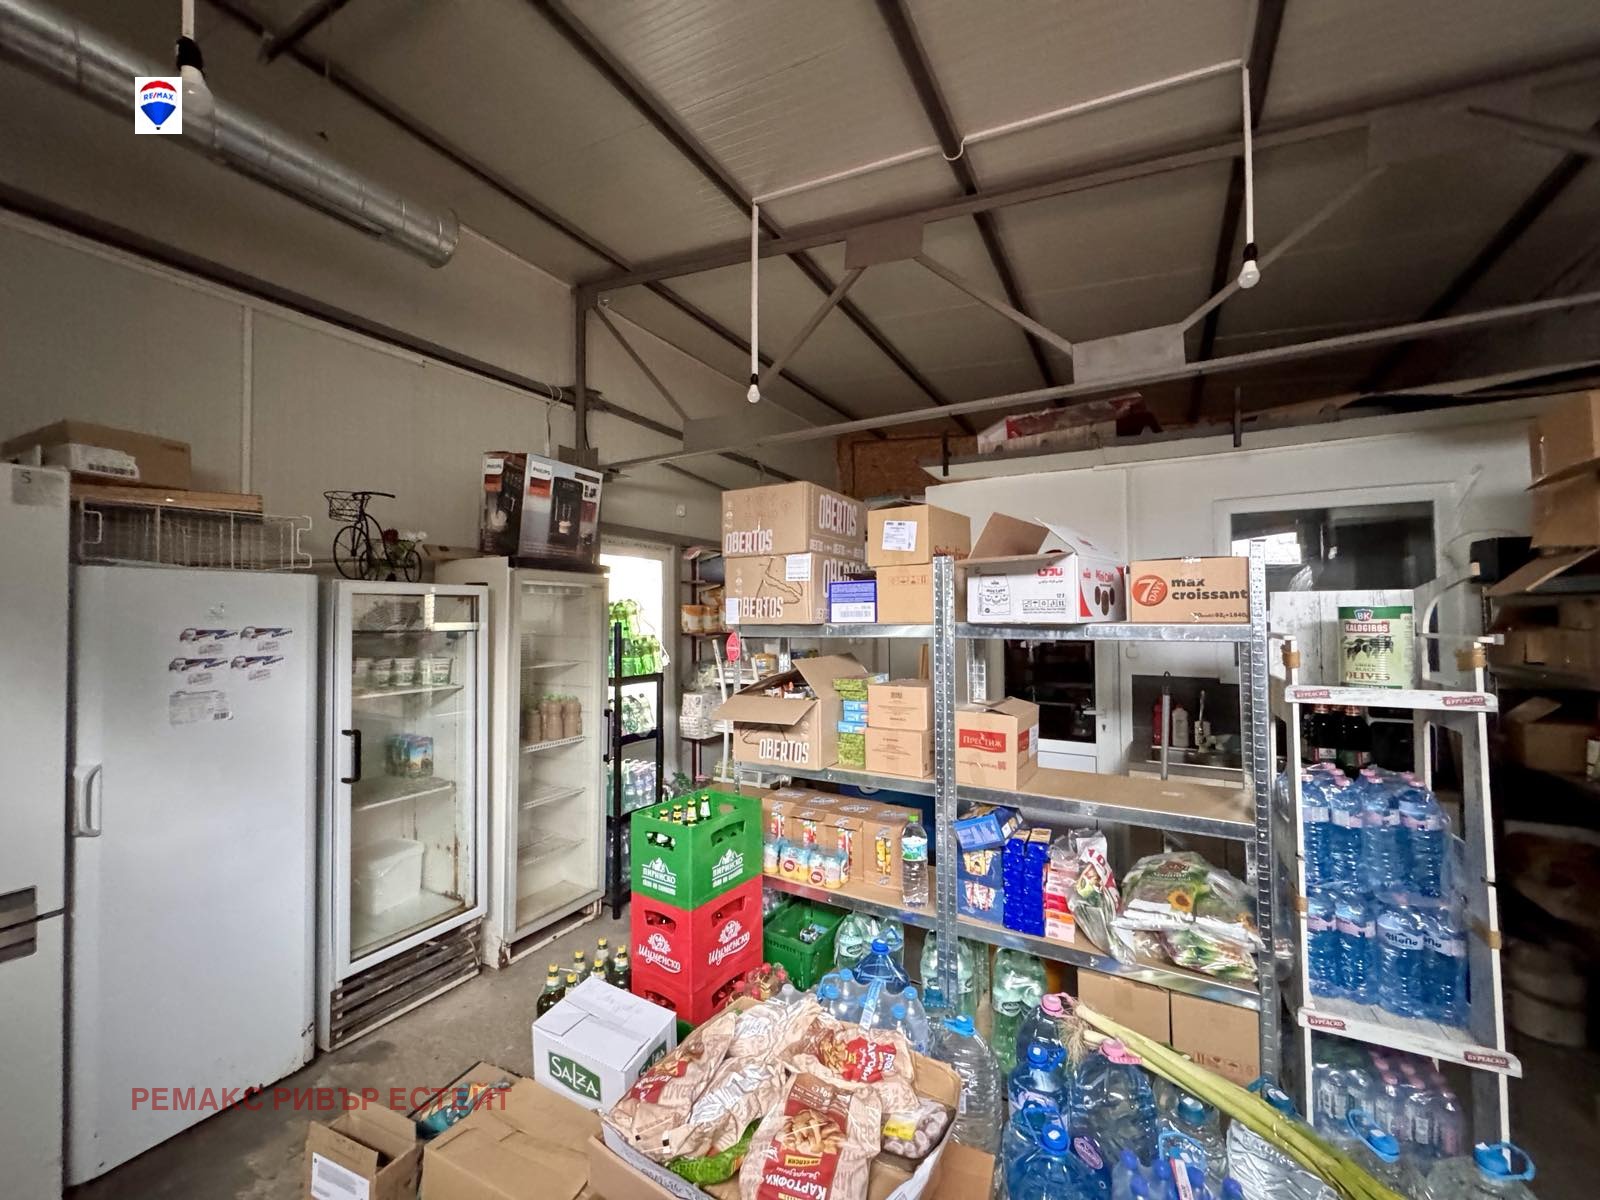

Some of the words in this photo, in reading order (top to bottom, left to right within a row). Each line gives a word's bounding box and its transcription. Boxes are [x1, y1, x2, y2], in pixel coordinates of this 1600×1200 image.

[819, 494, 857, 537] OBERTOS
[725, 529, 773, 555] OBERTOS
[1137, 579, 1155, 602] 7
[1149, 580, 1165, 602] DAYS
[1171, 578, 1205, 587] max
[1171, 589, 1249, 600] croissant
[1357, 612, 1370, 620] BK
[758, 738, 810, 764] OBERTOS
[963, 735, 1002, 749] ПРЕСТИЖ
[642, 867, 676, 885] ПИРИНСКО
[712, 856, 744, 876] ПИРИНСКО
